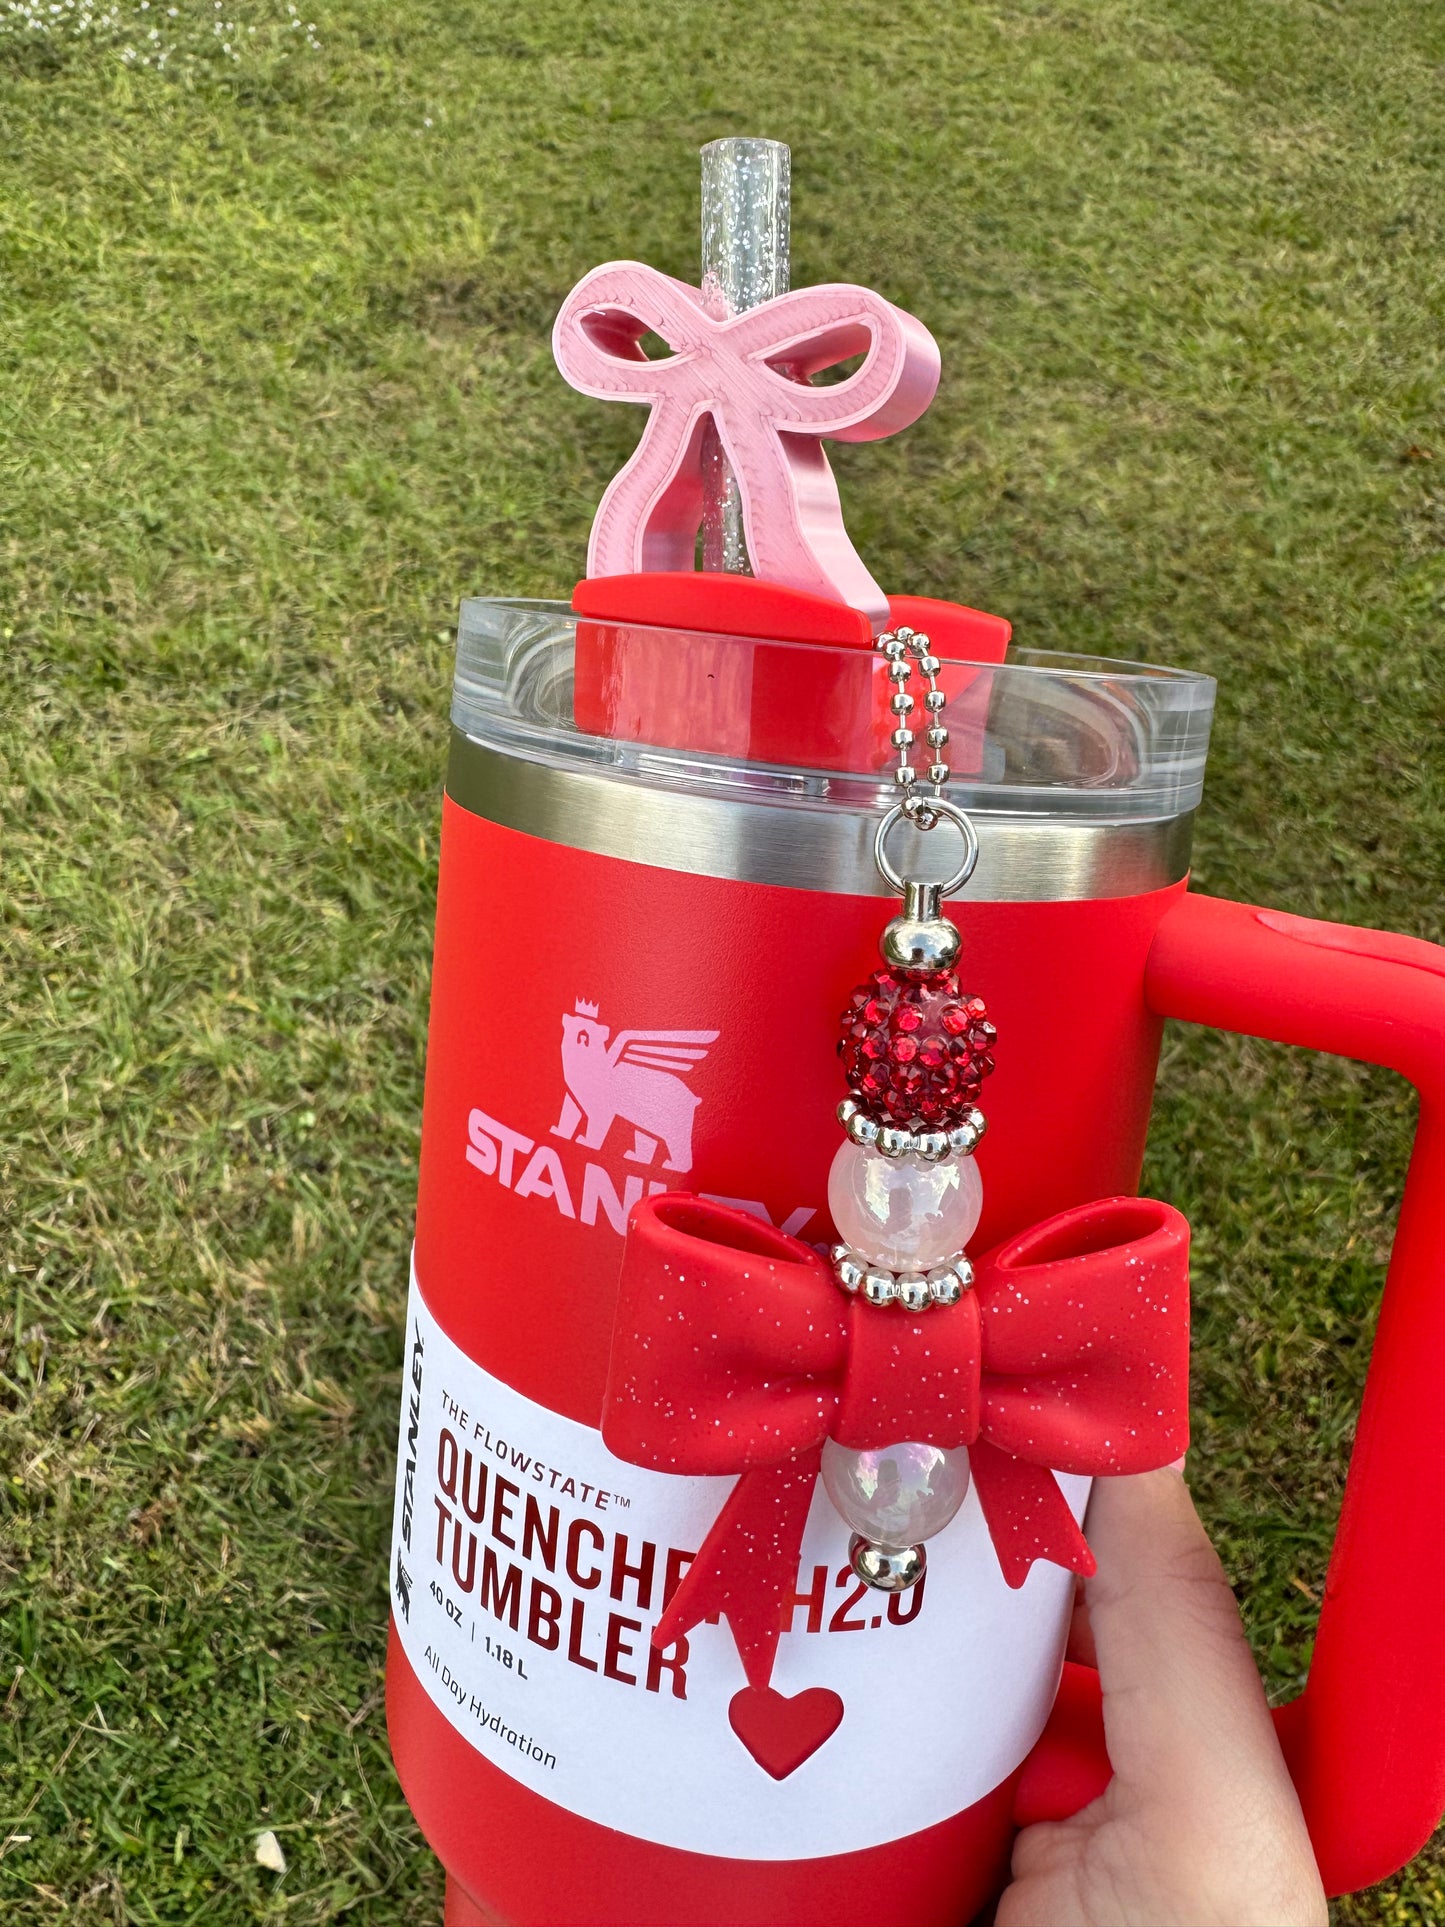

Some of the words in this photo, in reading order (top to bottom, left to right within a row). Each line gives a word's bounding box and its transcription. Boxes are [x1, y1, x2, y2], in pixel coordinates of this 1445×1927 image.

[402, 1316, 425, 1554] STANLEY
[442, 1389, 469, 1431] THE
[434, 1493, 690, 1701] TUMBLER
[437, 1427, 720, 1626] QUENCHE
[424, 1645, 440, 1674] All
[441, 1665, 467, 1705] Day
[469, 1695, 557, 1770] Hydration
[429, 1580, 443, 1606] 40
[445, 1598, 463, 1628] OZ
[485, 1636, 514, 1669] 1.18
[517, 1658, 528, 1681] L
